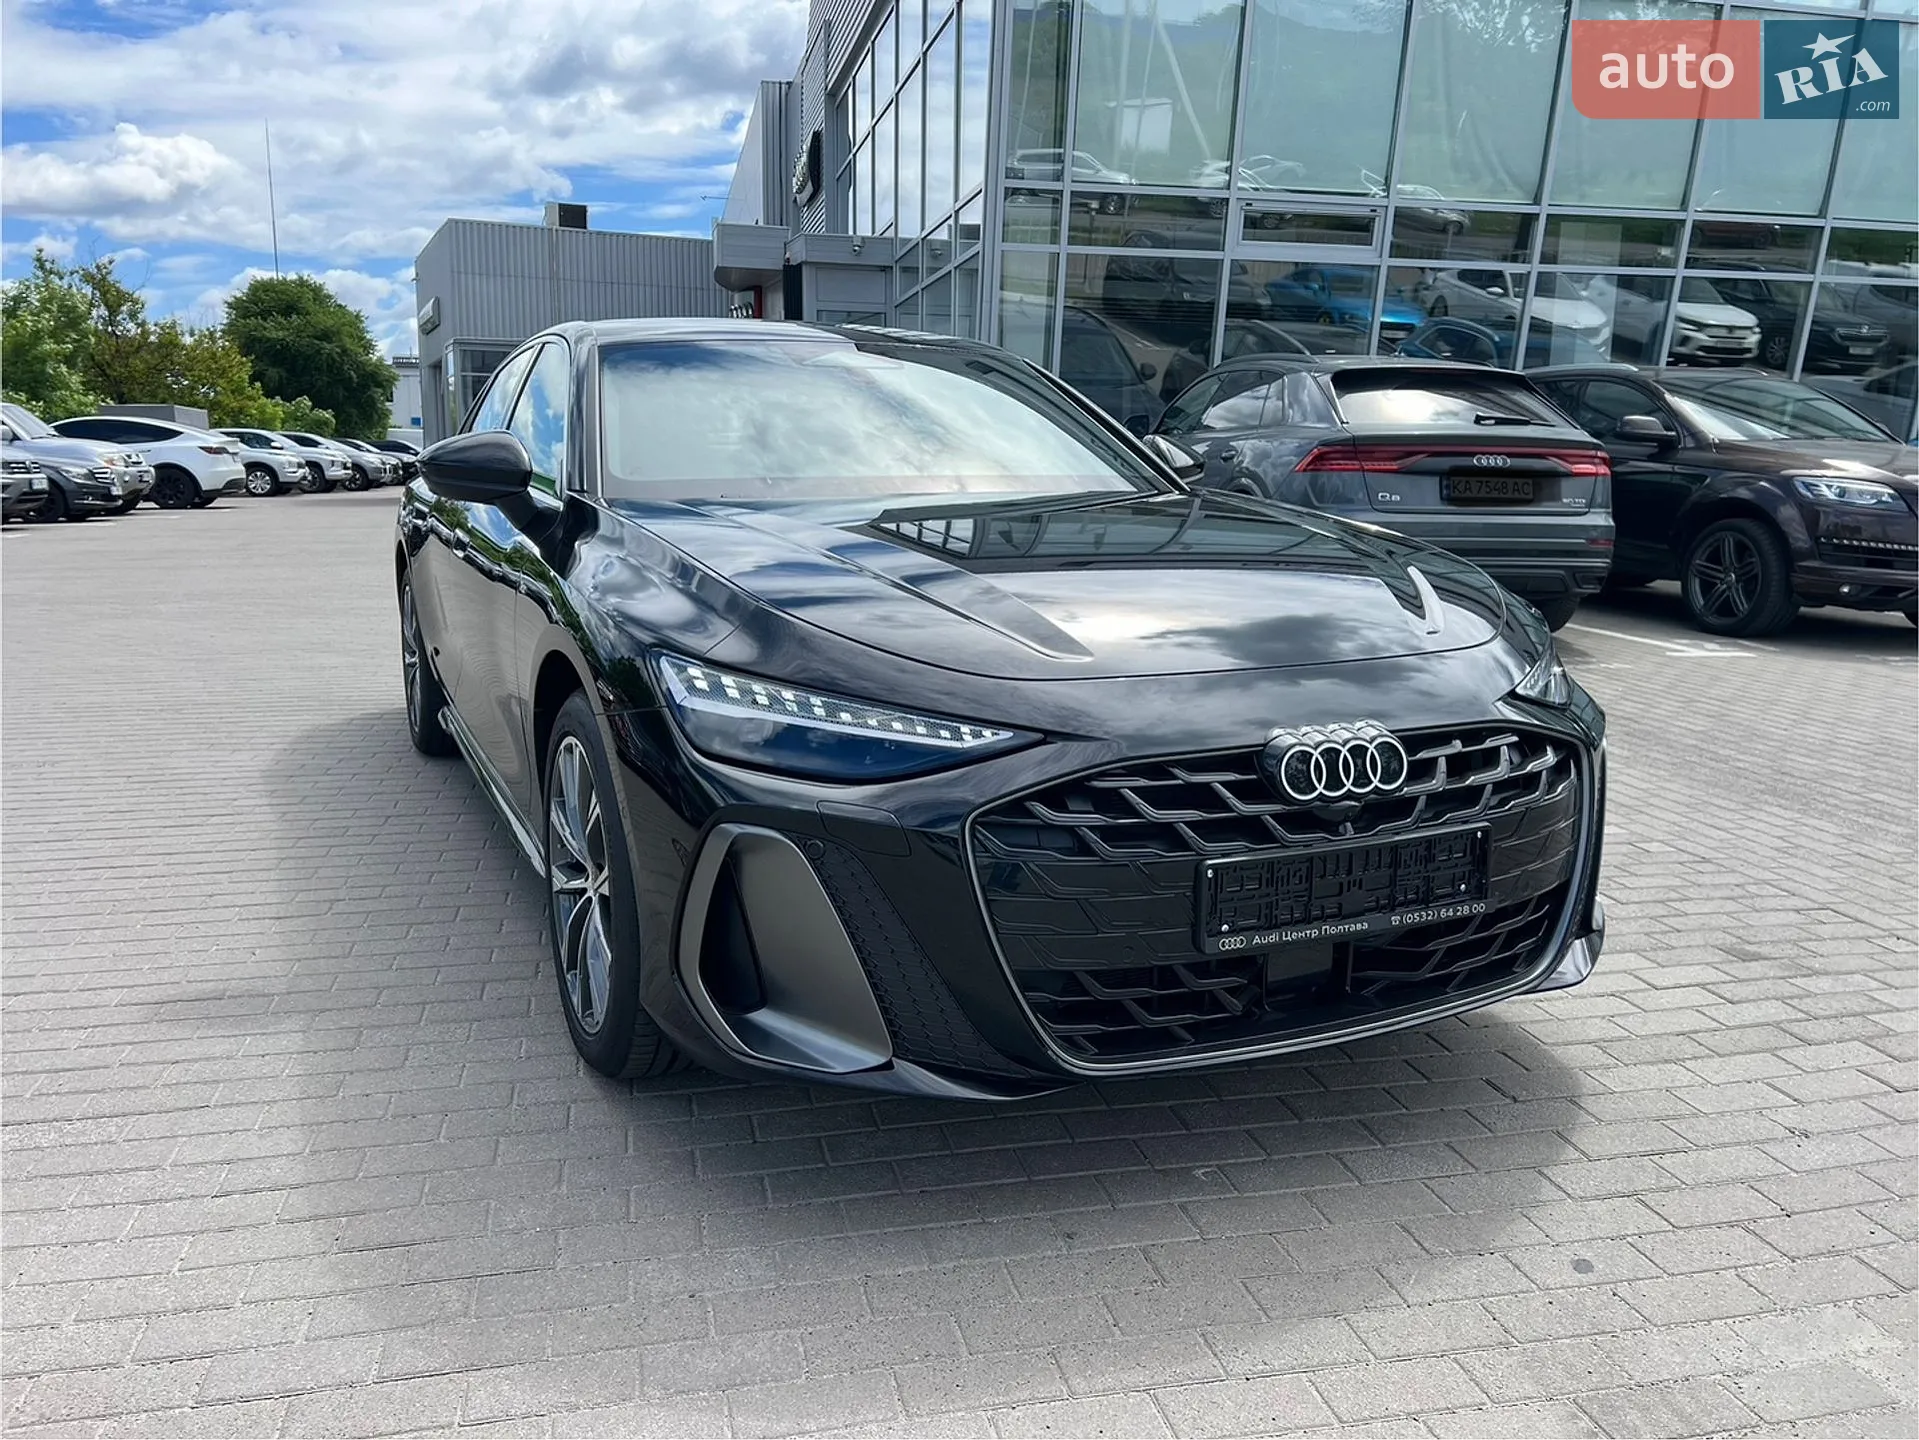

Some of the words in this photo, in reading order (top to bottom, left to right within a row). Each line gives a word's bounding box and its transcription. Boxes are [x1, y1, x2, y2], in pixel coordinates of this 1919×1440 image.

[1475, 480, 1509, 496] 7548
[1402, 910, 1438, 925] (0532)
[1440, 908, 1454, 918] 64
[1456, 905, 1470, 916] 28
[1472, 903, 1486, 913] 00
[1252, 932, 1279, 945] Audi
[1282, 928, 1319, 941] Центр
[1321, 921, 1368, 935] Полтава
